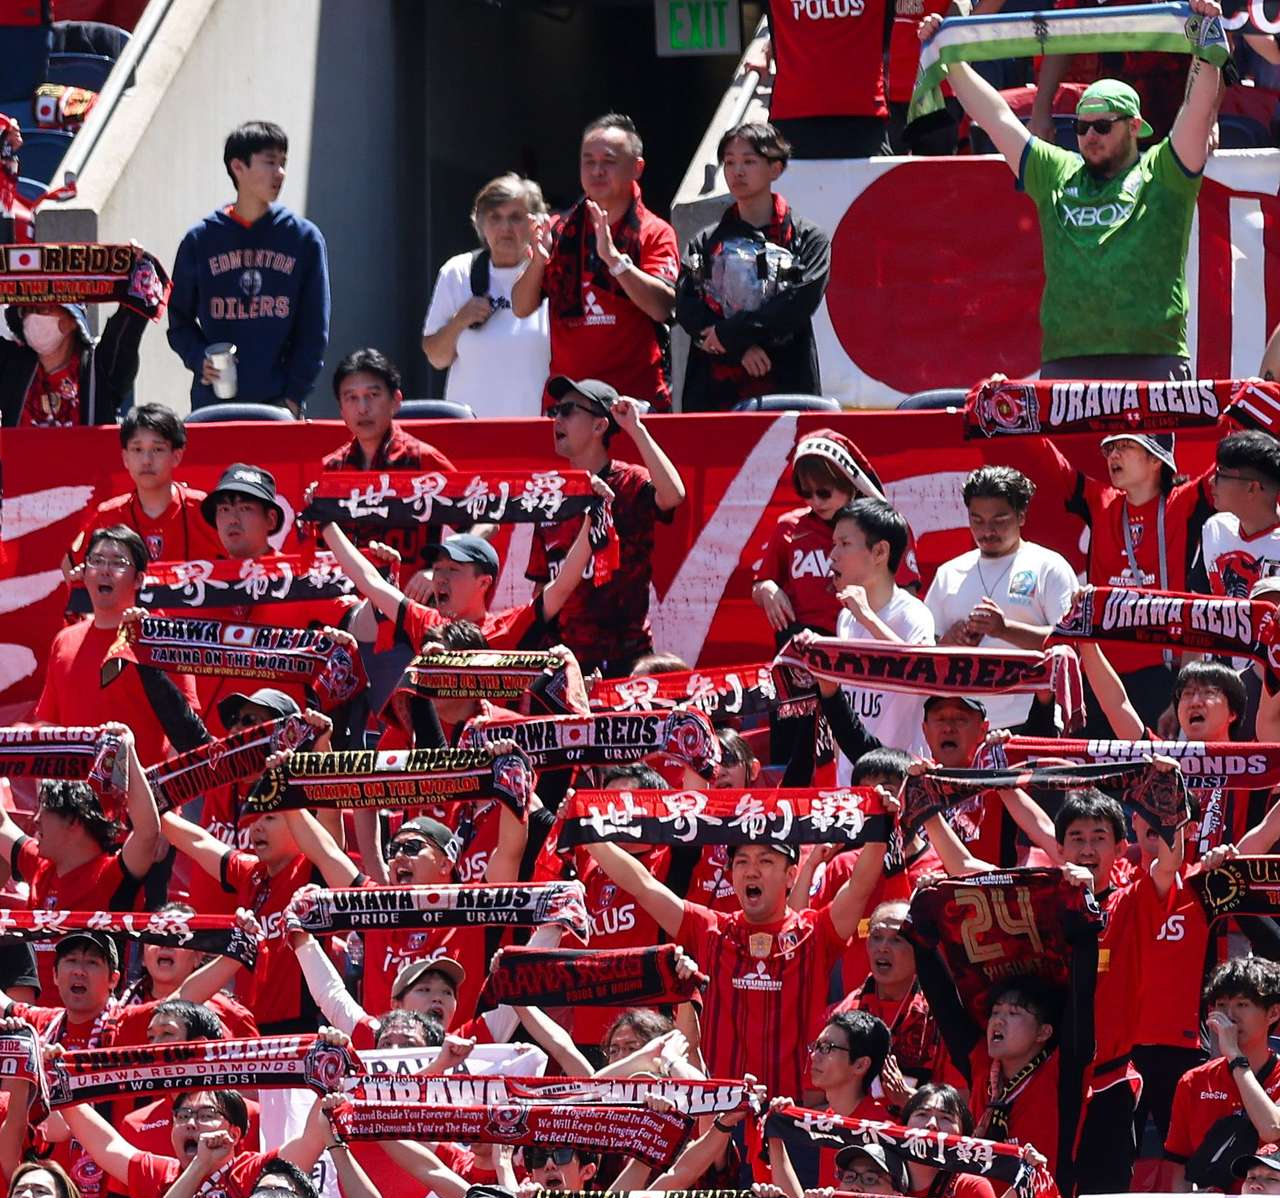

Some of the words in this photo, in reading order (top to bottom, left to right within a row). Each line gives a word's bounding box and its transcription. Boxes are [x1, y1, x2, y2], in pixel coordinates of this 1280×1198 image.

[670, 5, 729, 49] EXIT
[1062, 205, 1132, 228] XBOX
[42, 247, 131, 274] REDS
[209, 250, 297, 276] EDMONTON
[210, 297, 290, 319] OILERS
[1049, 383, 1138, 427] URAWA
[1147, 381, 1217, 417] REDS
[342, 470, 568, 519] 世界制覇
[1102, 586, 1182, 630] URAWA
[1192, 598, 1251, 643] REDS
[143, 617, 220, 643] URAWA
[255, 625, 333, 653] REDS
[594, 715, 658, 747] REDS
[289, 751, 375, 777] URAWA
[409, 747, 492, 771] REDS
[1088, 740, 1205, 756] URAWA
[304, 783, 356, 798] TAKING
[362, 780, 380, 796] ON
[386, 778, 412, 795] THE
[418, 777, 479, 794] WORLD!
[580, 792, 870, 841] 世界制覇
[334, 890, 413, 911] URAWA
[456, 888, 530, 908] REDS
[351, 914, 399, 926] PRIDE
[423, 912, 442, 923] OF
[467, 911, 518, 923] URAWA
[957, 889, 1042, 961] 24
[77, 1071, 146, 1086] URAWA
[151, 1065, 187, 1077] RED
[197, 1060, 297, 1075] DIAMONDS
[130, 1080, 154, 1091] We
[163, 1078, 192, 1089] are
[203, 1073, 258, 1087] REDS!
[794, 1112, 997, 1171] 世界制覇
